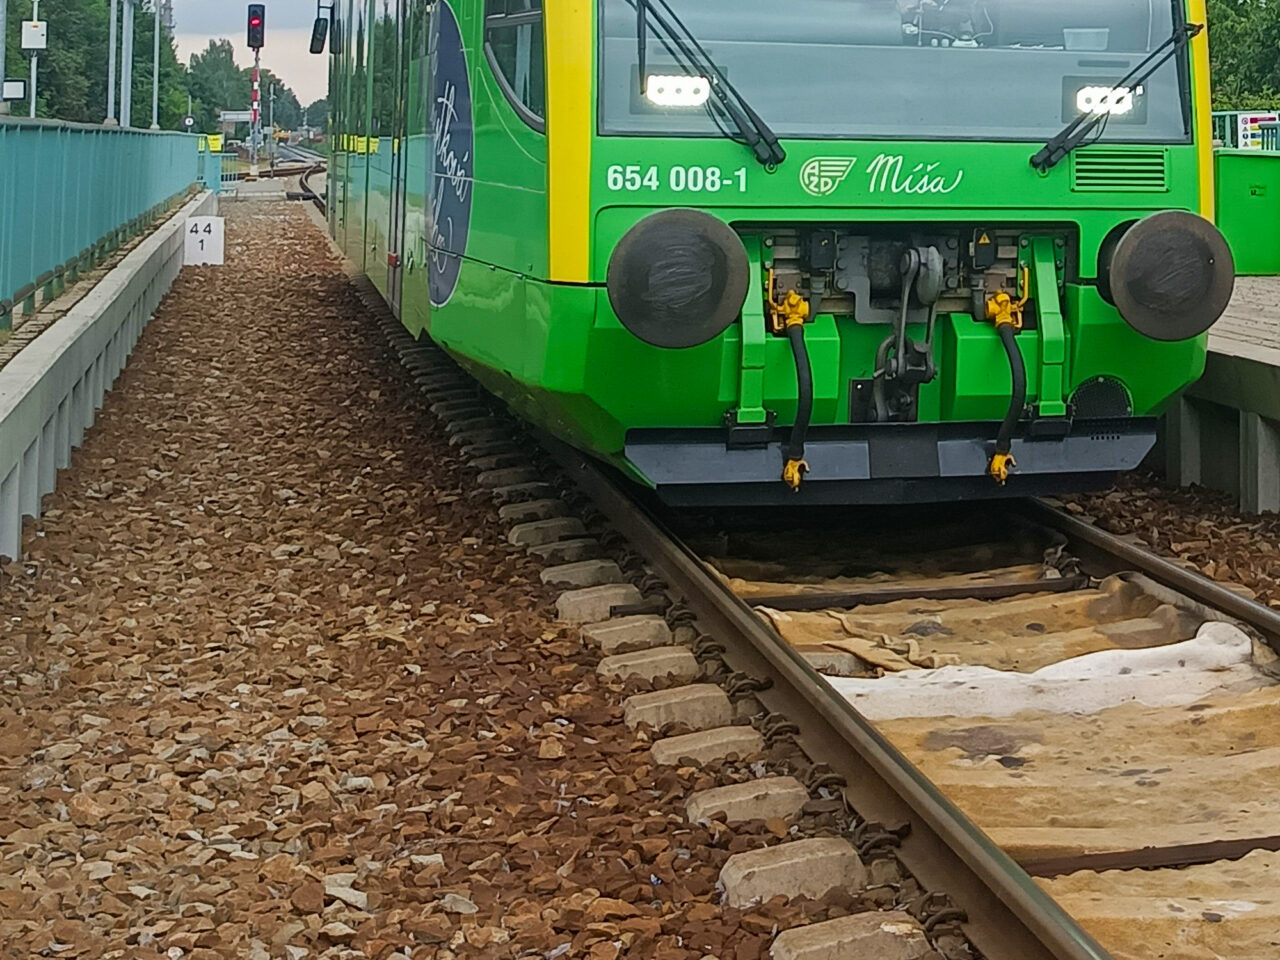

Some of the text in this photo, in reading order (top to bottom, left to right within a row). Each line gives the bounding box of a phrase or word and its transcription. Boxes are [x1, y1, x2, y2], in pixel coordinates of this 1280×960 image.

[607, 164, 748, 193] 654 008-1
[866, 153, 963, 194] Míša
[190, 222, 212, 235] 44
[198, 239, 204, 251] 1
